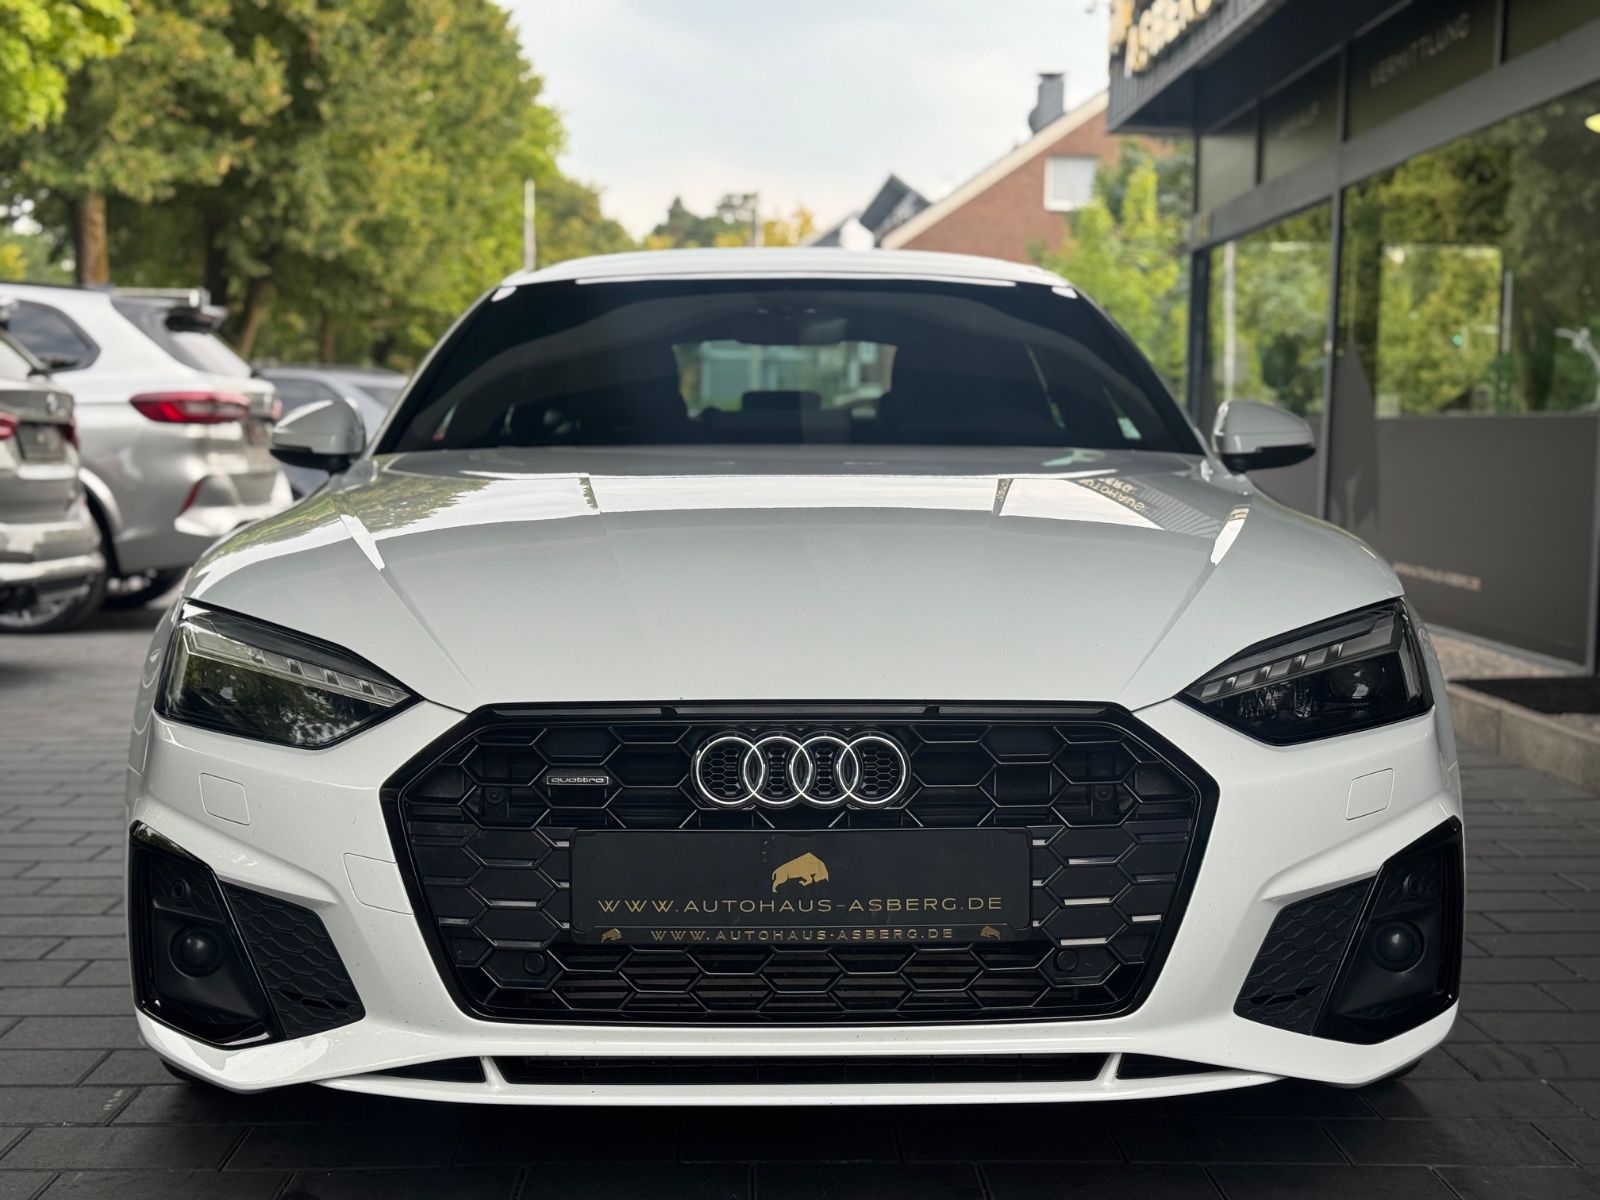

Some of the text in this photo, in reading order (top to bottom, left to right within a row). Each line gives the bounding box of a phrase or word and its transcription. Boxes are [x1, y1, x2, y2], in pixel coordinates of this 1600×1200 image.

[550, 776, 606, 784] quattro
[597, 896, 1003, 914] WWW.AUTOHAUS-ASBERG.DE
[650, 927, 954, 942] WWW.AUTOHAUS-ASBERG.DE
